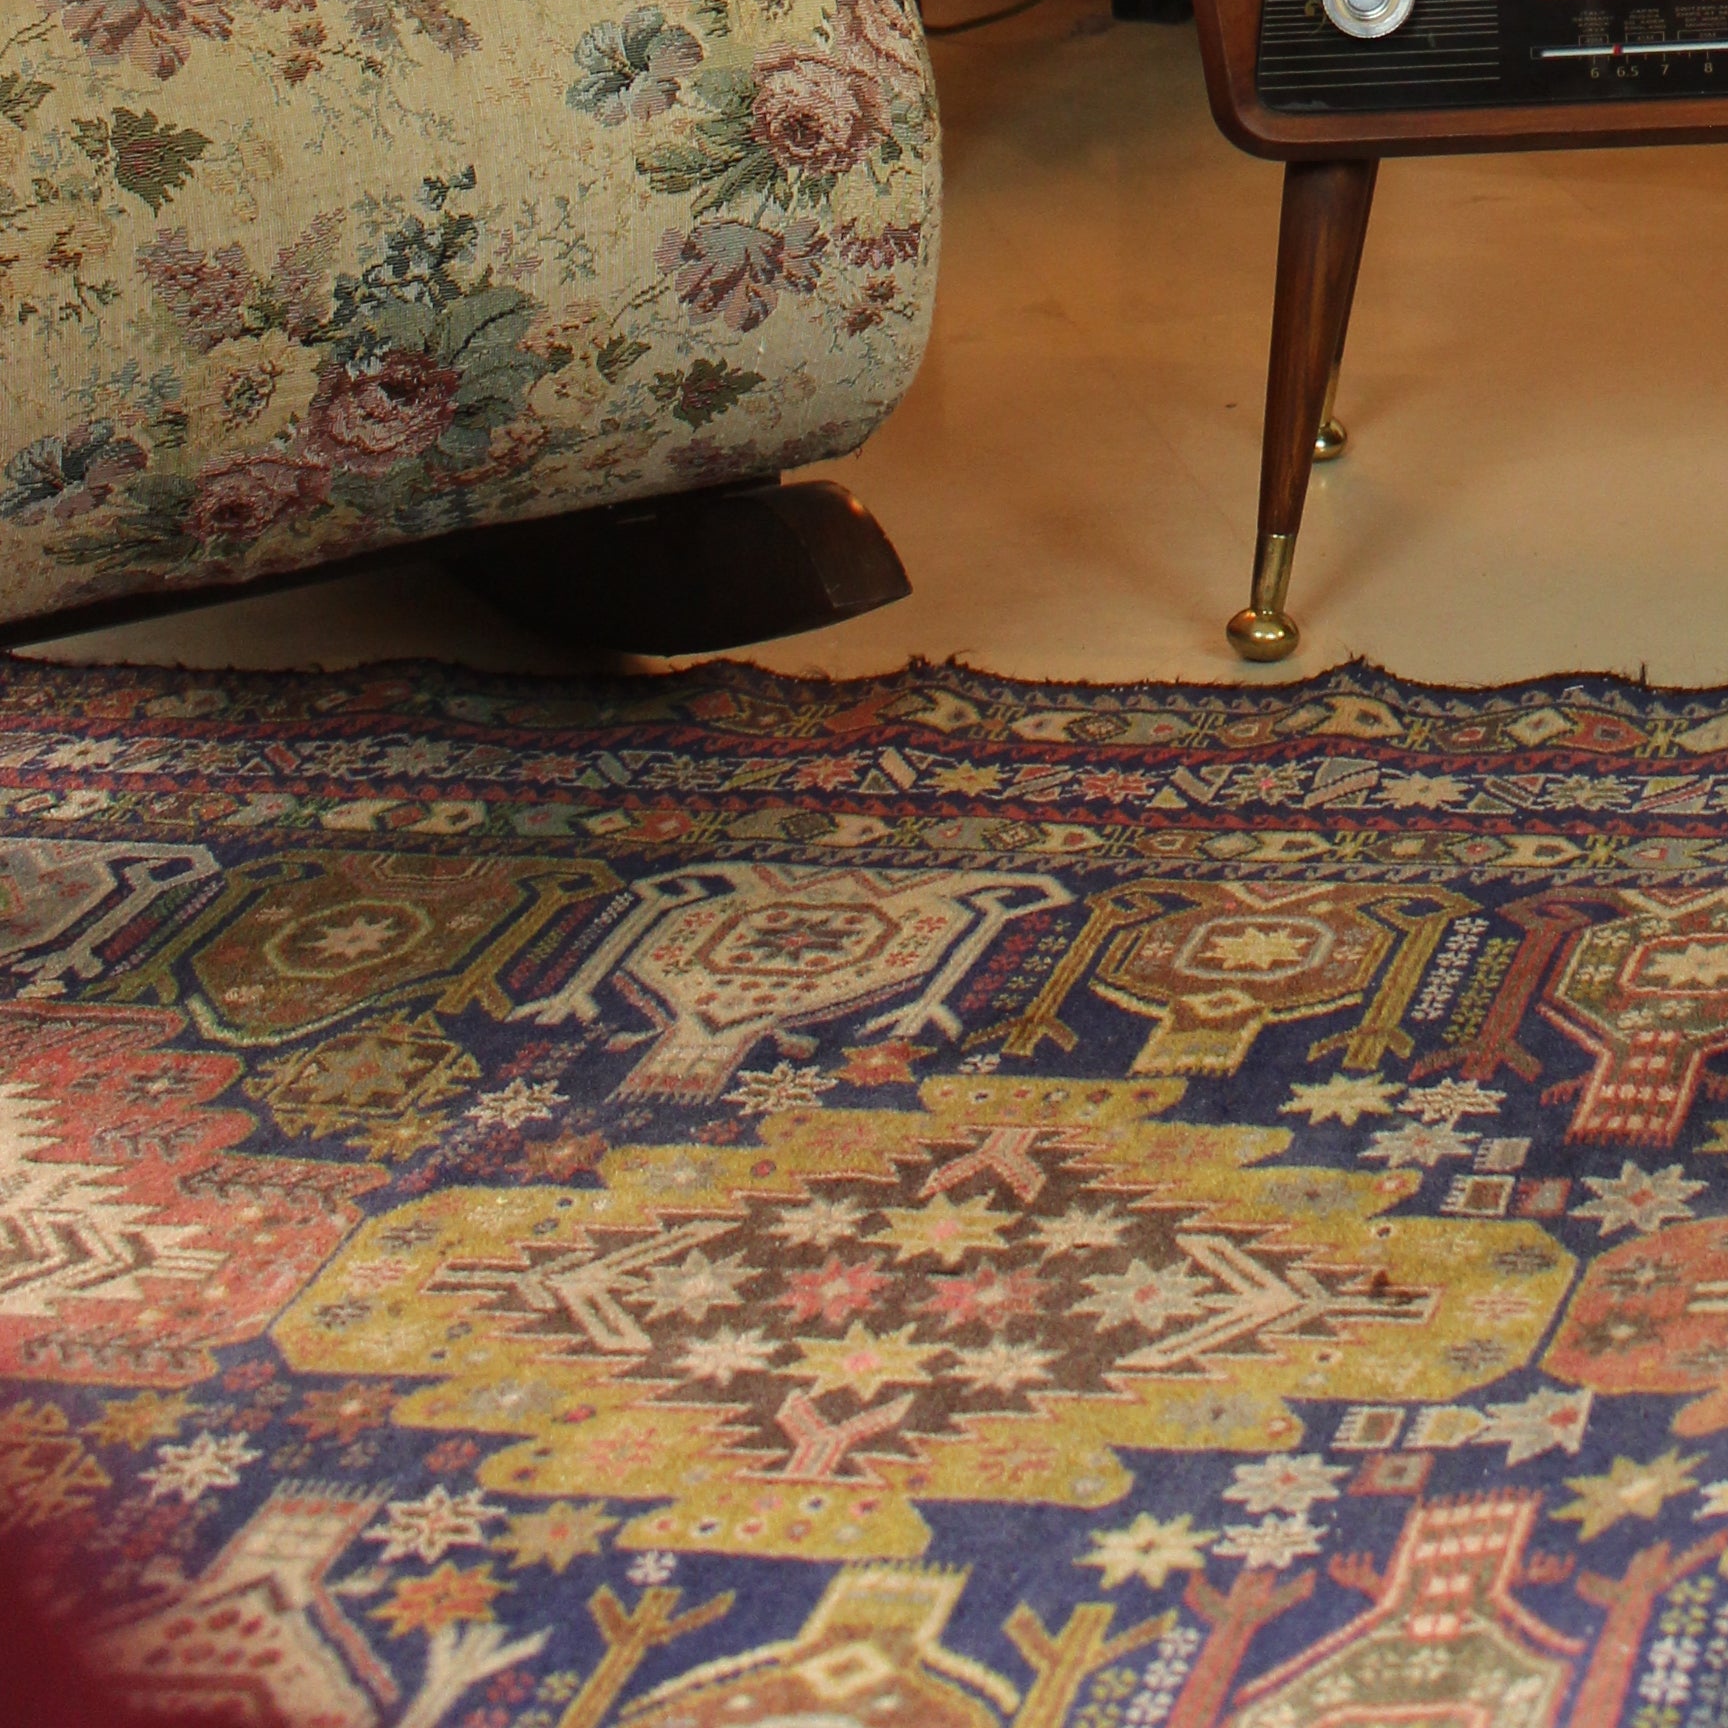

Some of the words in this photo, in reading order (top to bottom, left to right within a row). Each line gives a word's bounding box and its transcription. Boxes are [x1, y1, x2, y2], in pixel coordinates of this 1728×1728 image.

[1591, 67, 1600, 78] 6
[1617, 65, 1639, 78] 6.5
[1661, 64, 1669, 75] 7
[1704, 62, 1713, 73] 8
